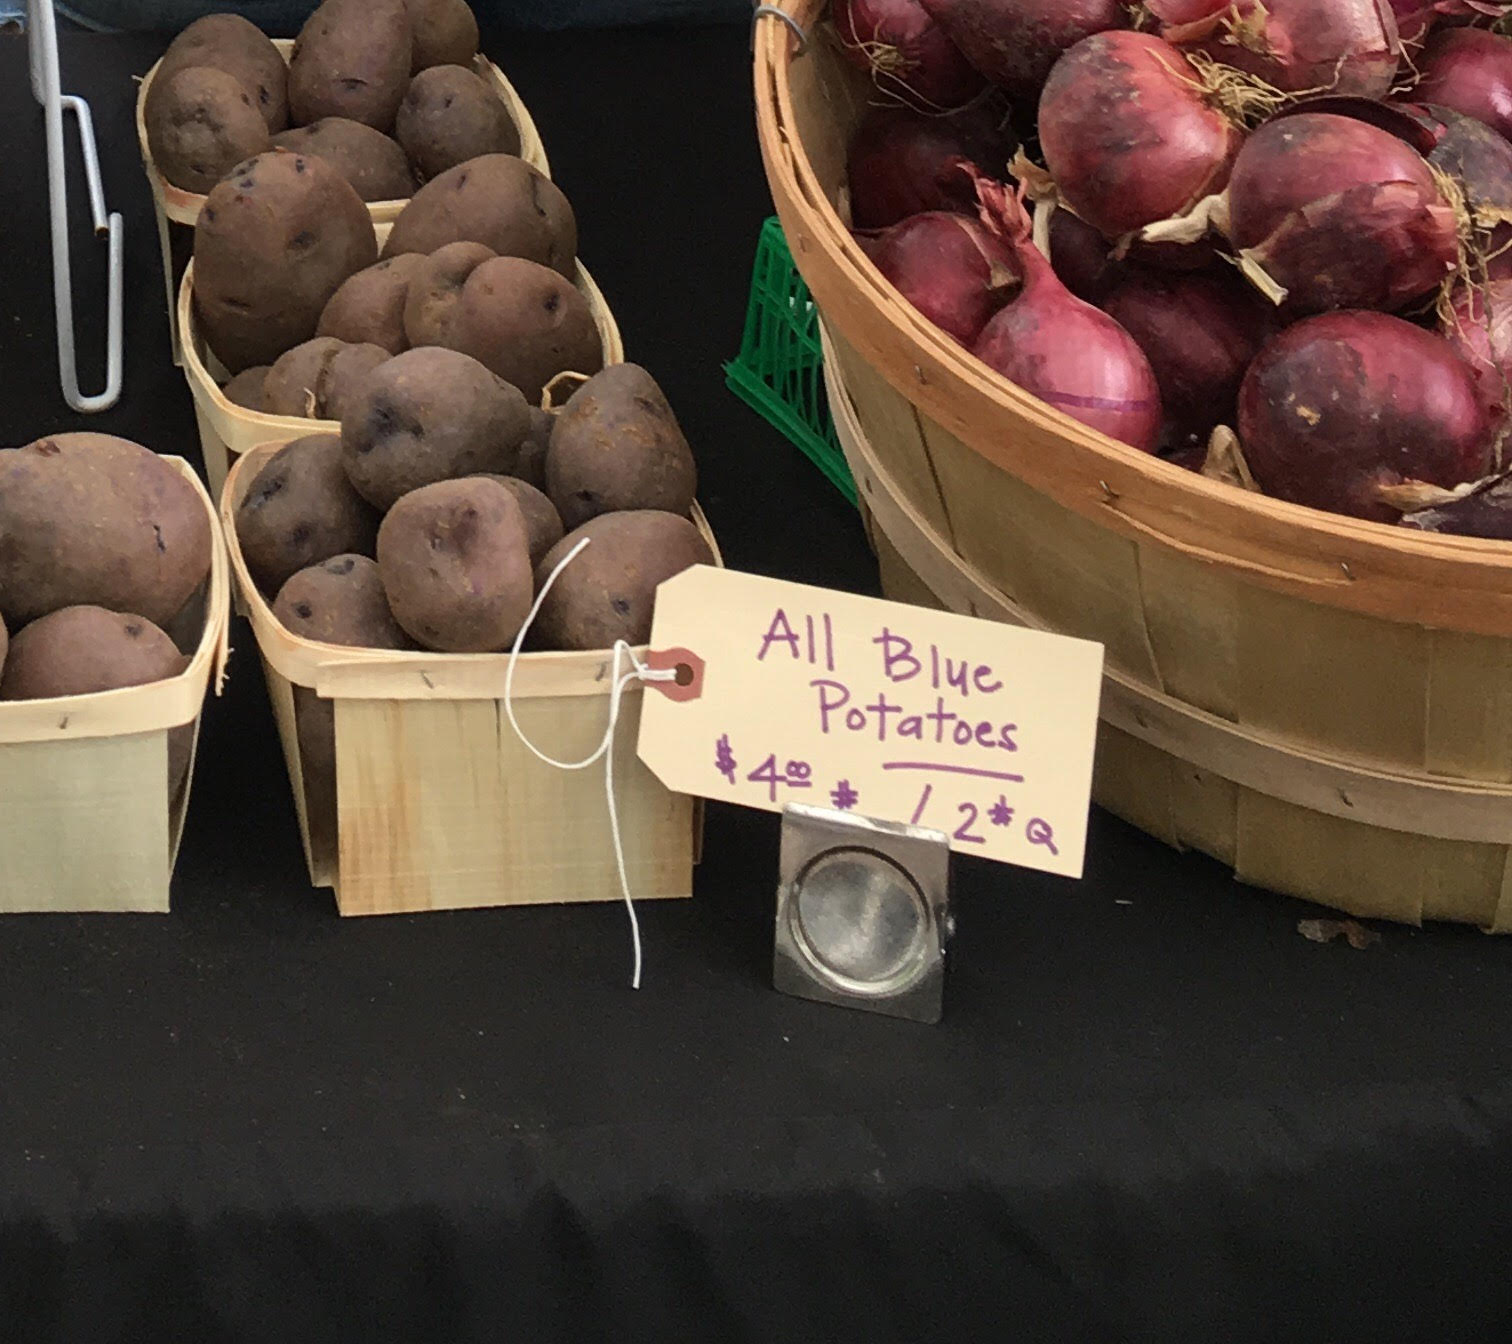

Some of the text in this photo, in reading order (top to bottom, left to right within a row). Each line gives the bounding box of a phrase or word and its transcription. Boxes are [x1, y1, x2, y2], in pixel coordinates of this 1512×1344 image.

[756, 607, 1004, 698] All Blue
[809, 678, 1019, 753] Potatoes
